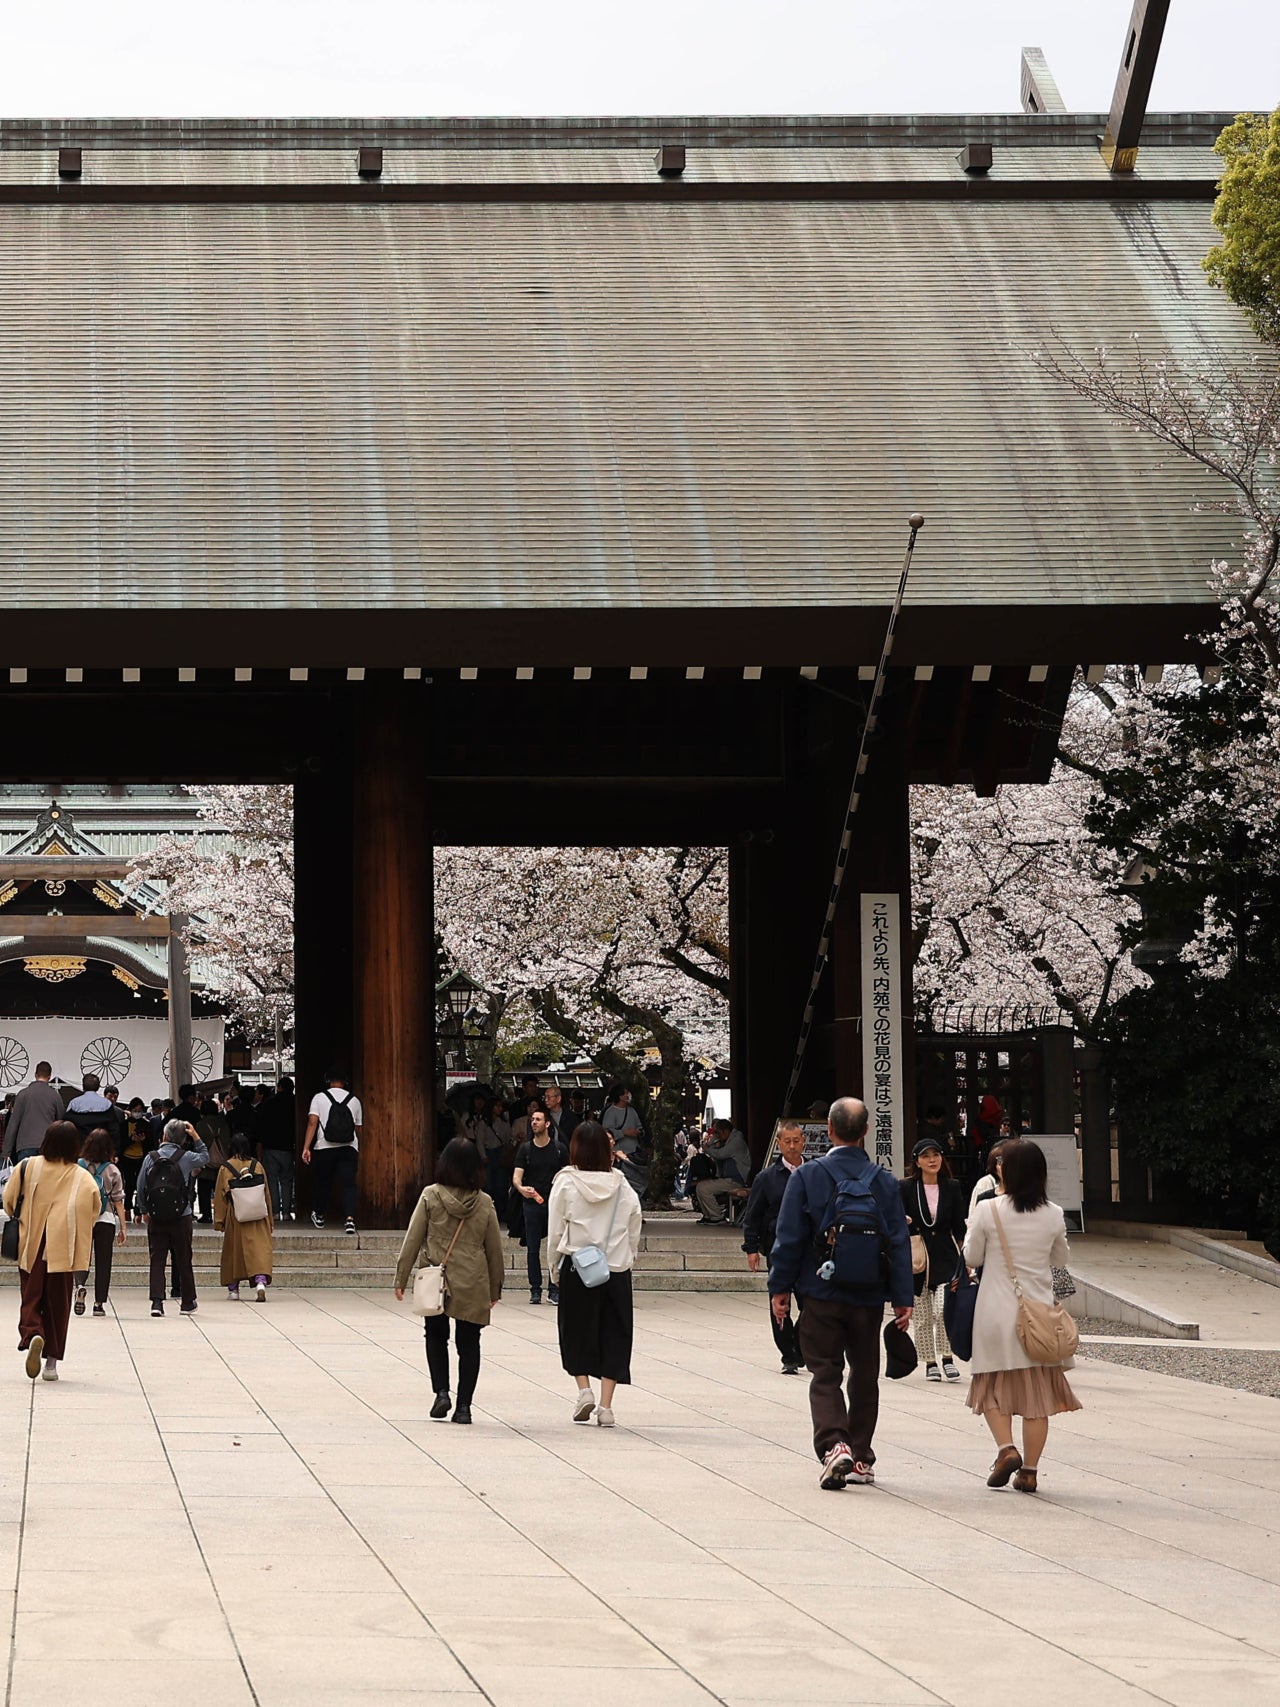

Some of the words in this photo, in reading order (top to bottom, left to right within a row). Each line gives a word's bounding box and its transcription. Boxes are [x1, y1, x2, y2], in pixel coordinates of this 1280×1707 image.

[872, 902, 893, 1171] これより先、内苑での花見の宴はご遠慮願い
